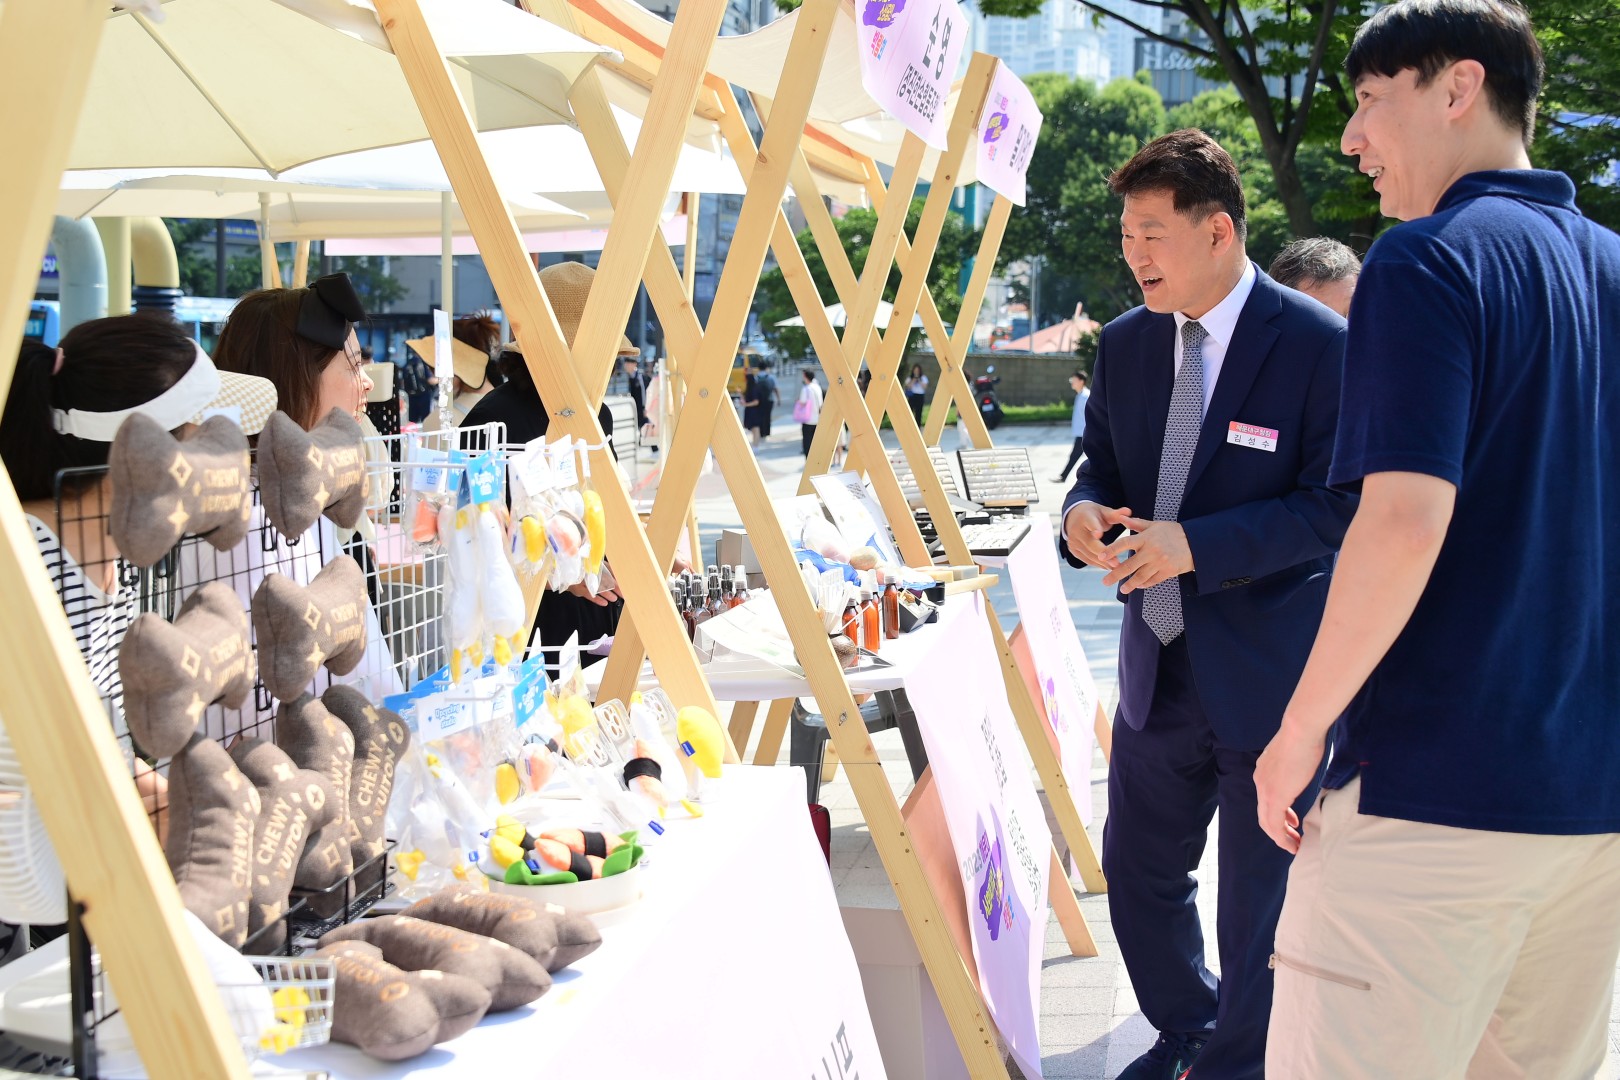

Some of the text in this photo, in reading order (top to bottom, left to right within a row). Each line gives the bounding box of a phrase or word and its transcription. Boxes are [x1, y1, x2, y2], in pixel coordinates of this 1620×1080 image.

[357, 740, 384, 807] CHEWY
[373, 747, 396, 818] VUITON
[231, 810, 249, 889] CHEWY
[255, 797, 292, 866] CHEWY
